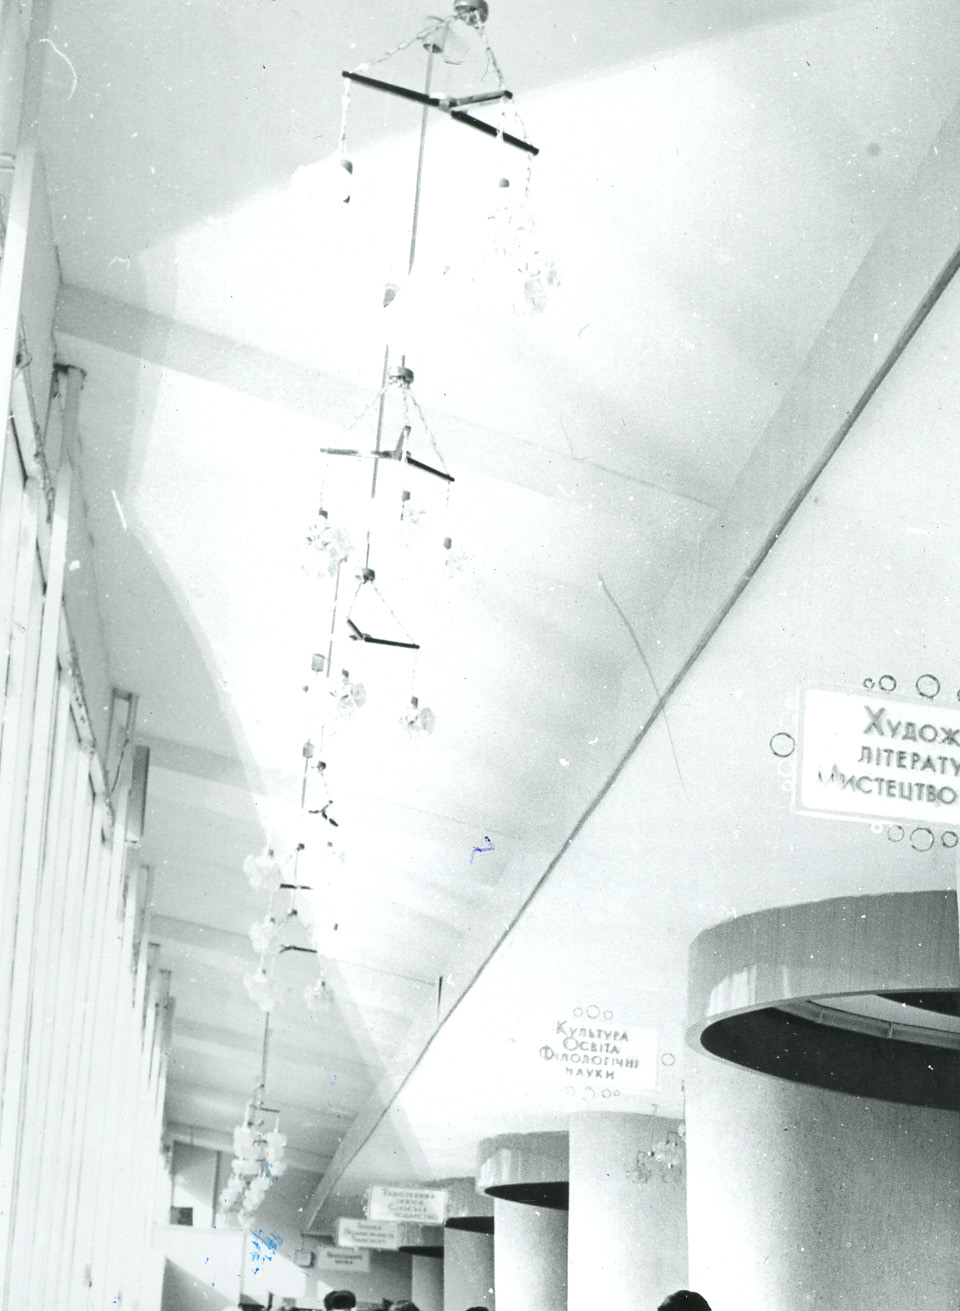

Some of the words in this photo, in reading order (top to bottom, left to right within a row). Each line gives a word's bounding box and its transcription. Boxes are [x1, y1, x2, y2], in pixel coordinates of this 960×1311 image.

[555, 1020, 630, 1042] КУЛЬТУРА
[562, 1036, 620, 1054] ОСВІТА
[565, 1067, 615, 1080] НАУКИ
